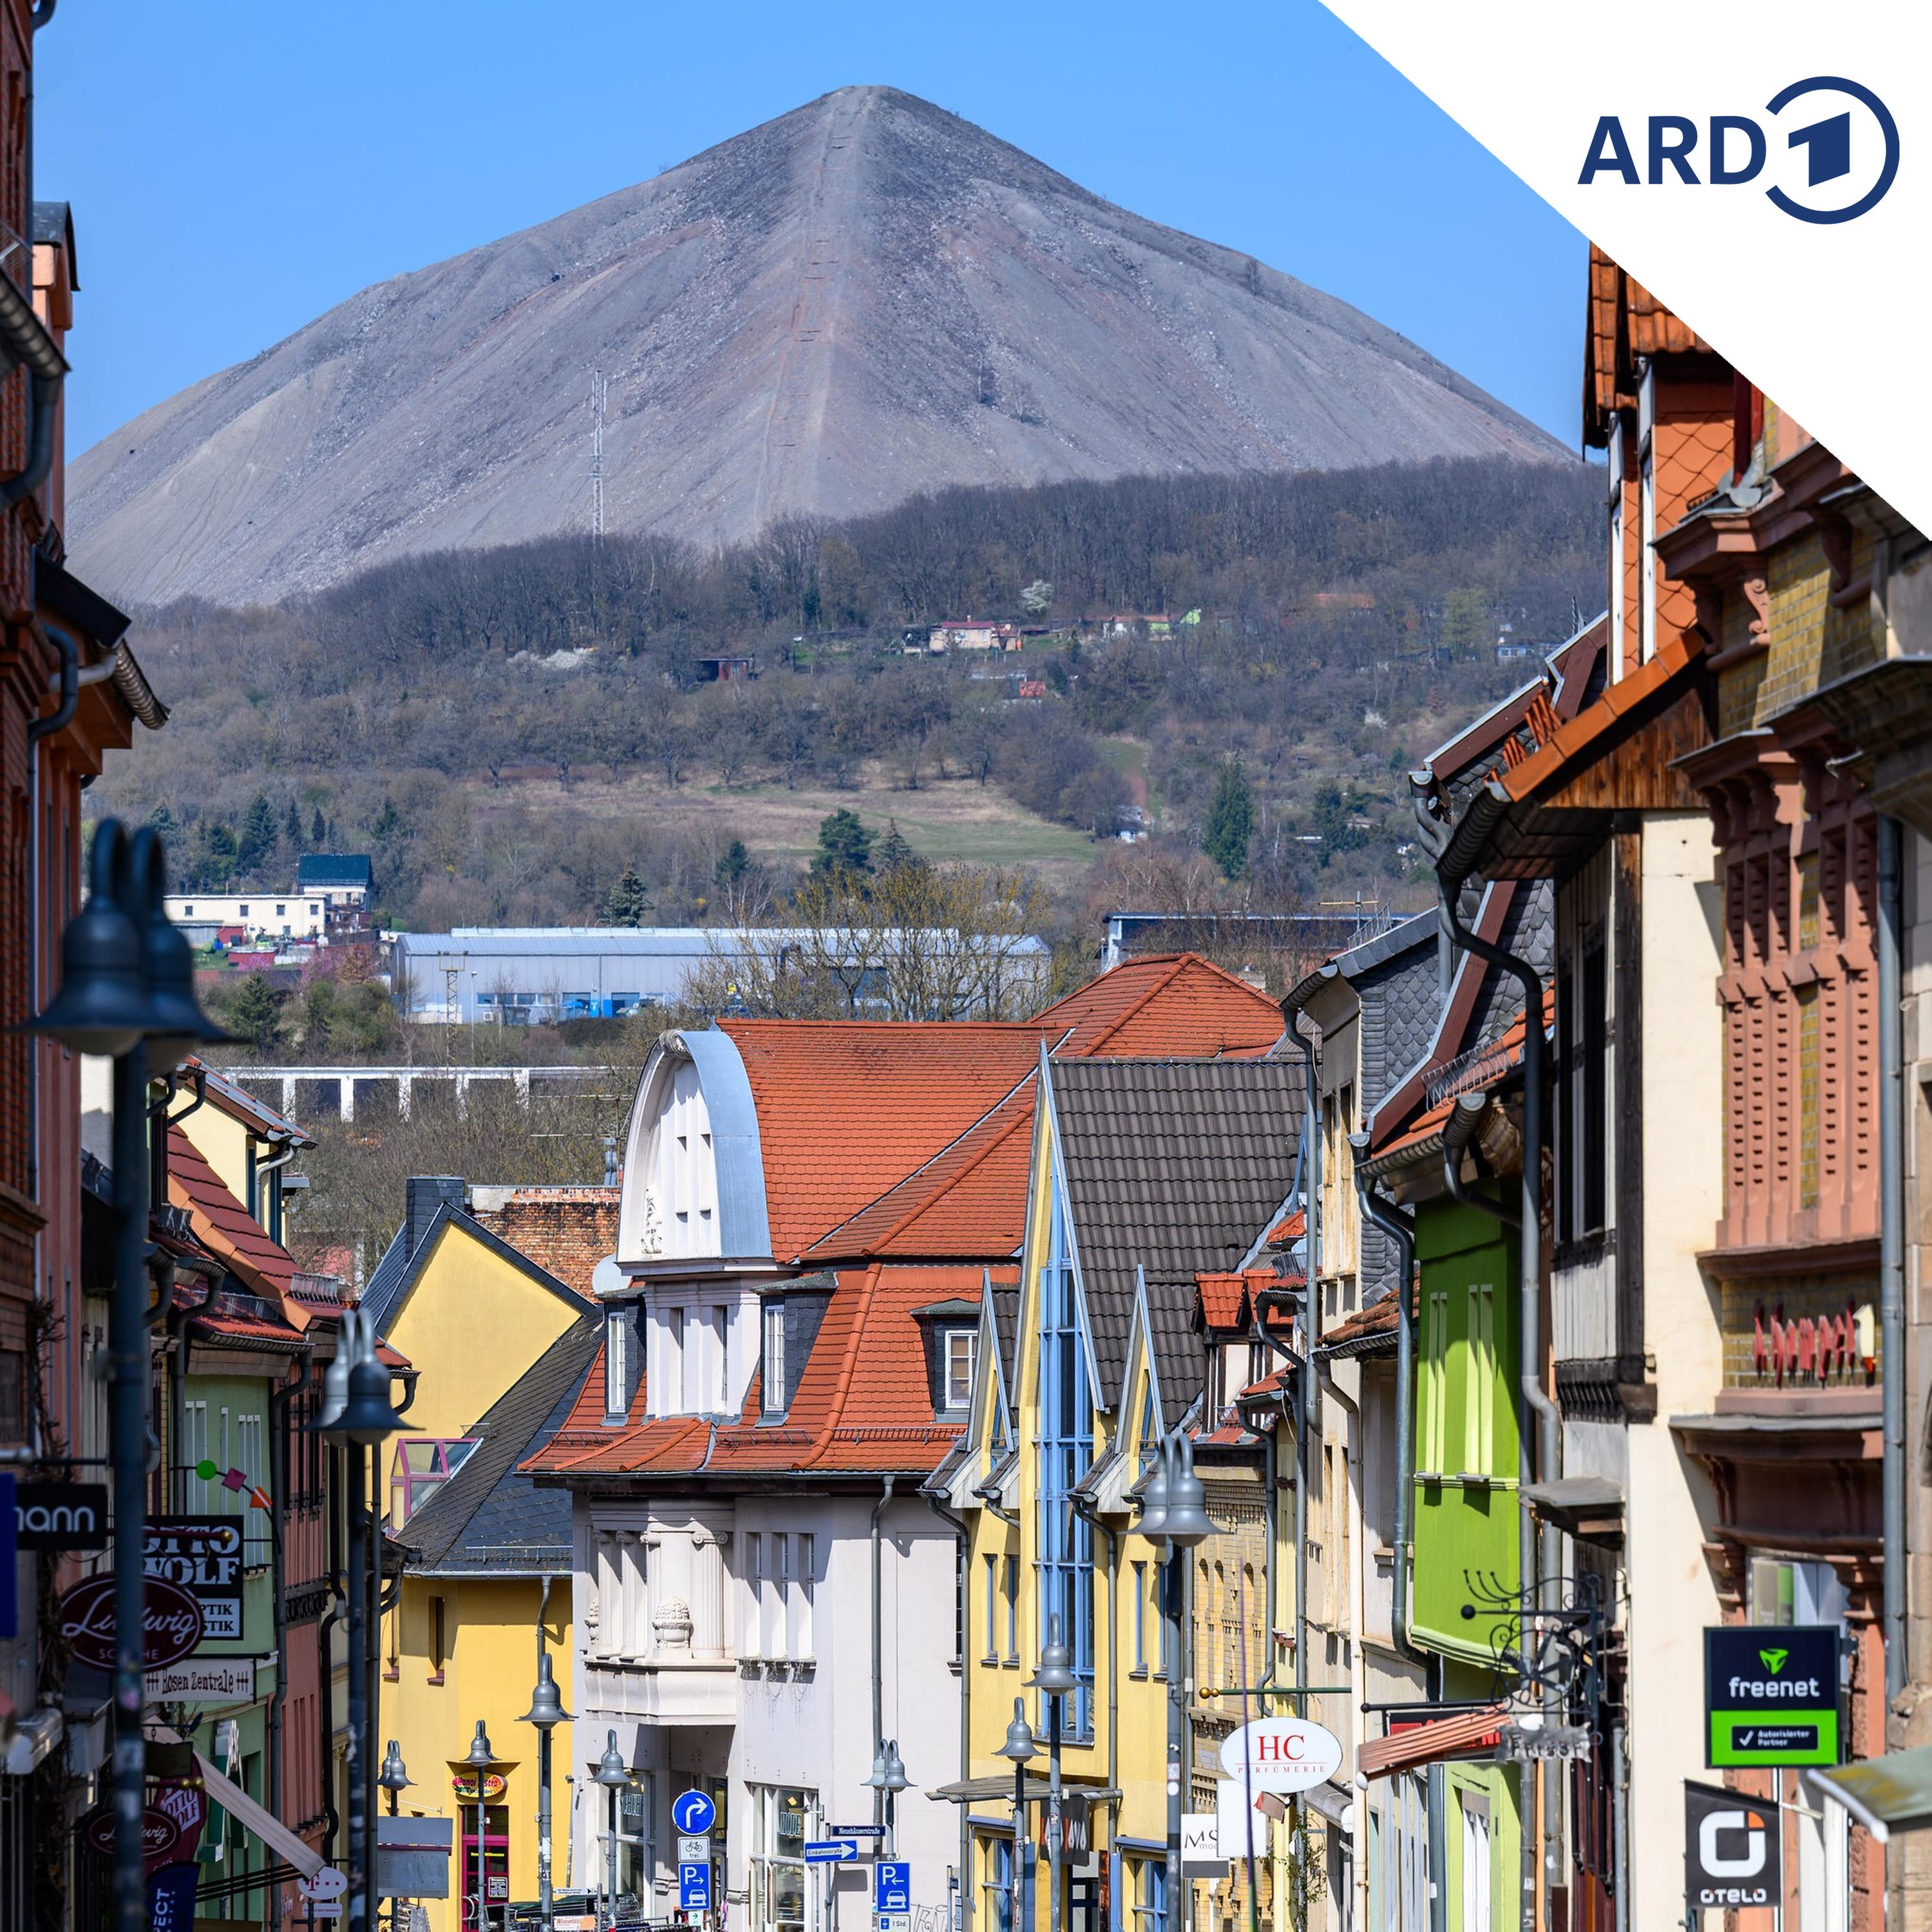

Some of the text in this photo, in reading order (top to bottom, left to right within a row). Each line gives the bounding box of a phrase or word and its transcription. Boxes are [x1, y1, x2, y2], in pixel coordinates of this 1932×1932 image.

[62, 1587, 196, 1645] Luwig
[99, 1649, 159, 1660] SCHE
[162, 1669, 234, 1694] Hosen Zentrale
[1728, 1676, 1821, 1698] freenet
[1258, 1734, 1305, 1761] HC
[1238, 1765, 1327, 1774] PRFÜMERIE
[685, 1867, 697, 1885] P
[882, 1866, 896, 1886] P
